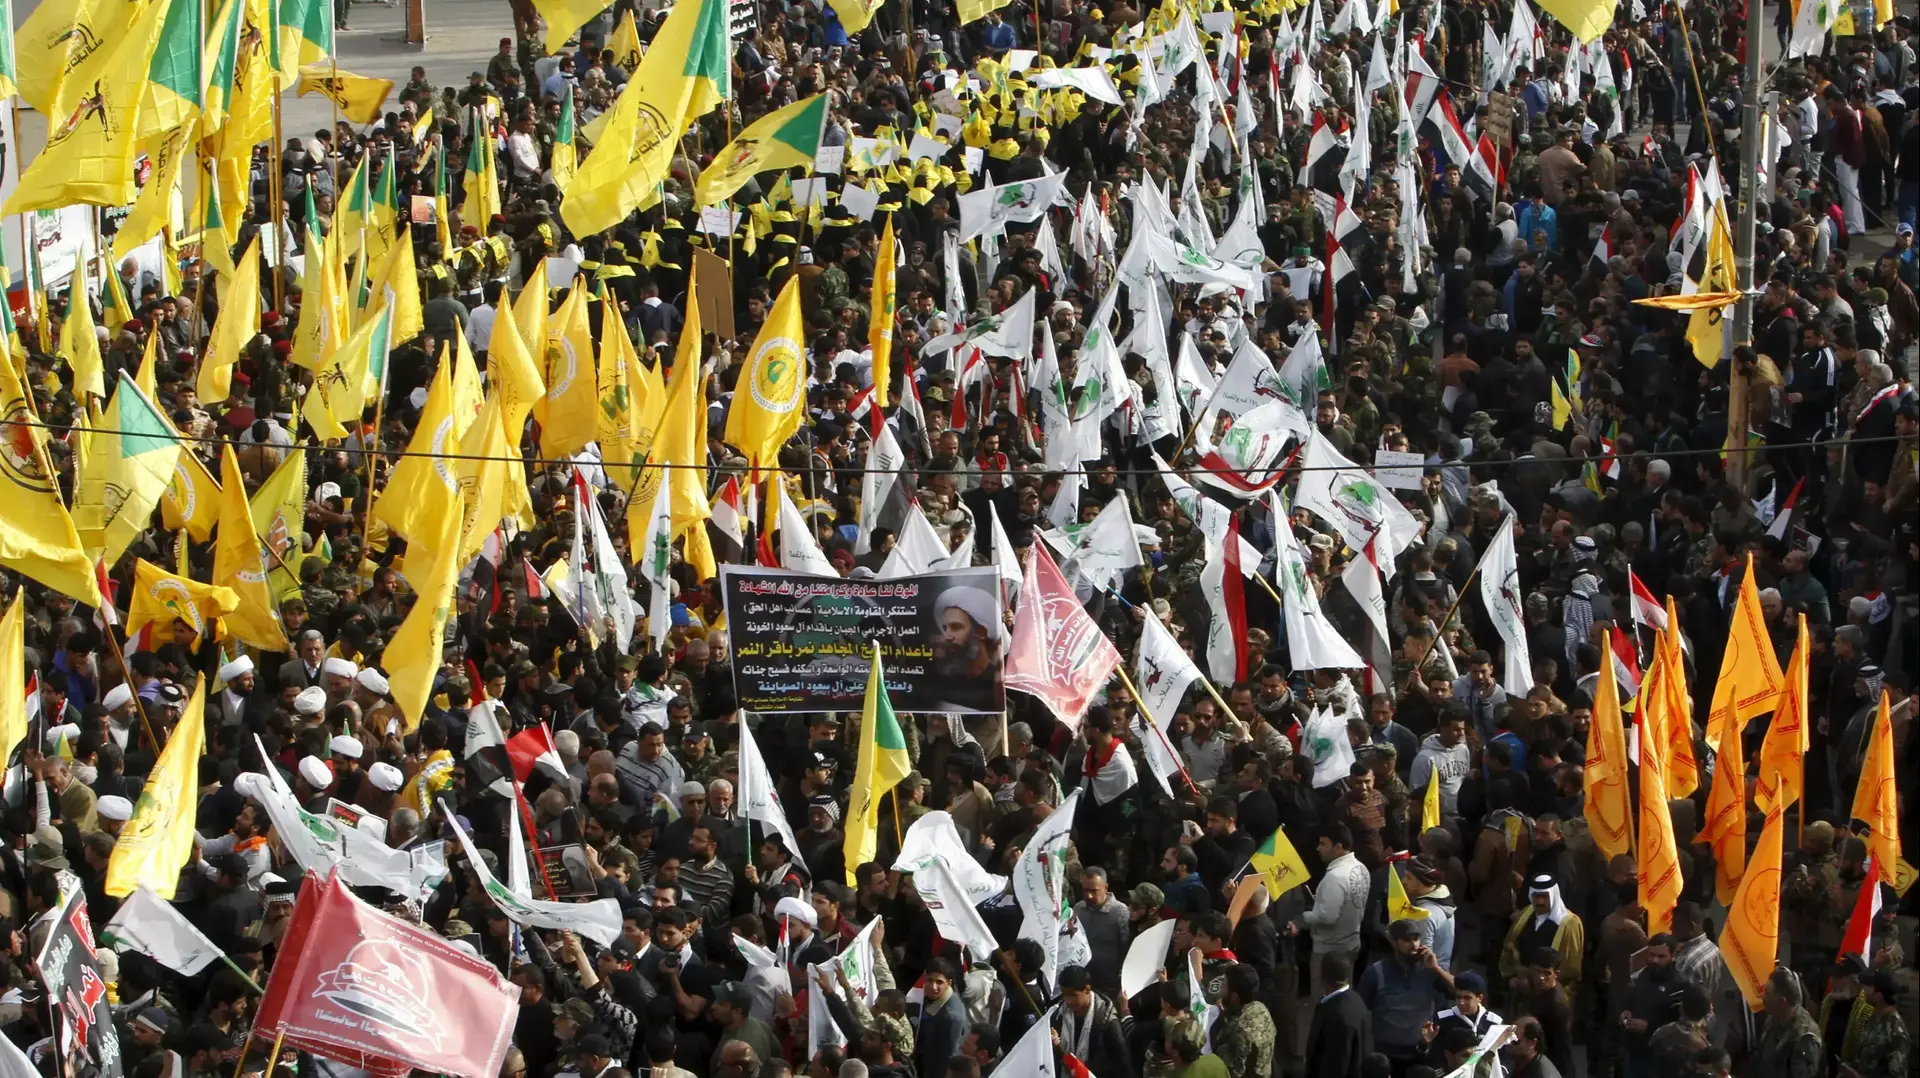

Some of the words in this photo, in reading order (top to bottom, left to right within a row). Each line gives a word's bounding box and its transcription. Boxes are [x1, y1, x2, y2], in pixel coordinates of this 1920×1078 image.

[739, 580, 776, 595] الشهادة
[777, 580, 794, 595] الله
[794, 583, 809, 598] من
[853, 584, 877, 597] عادة
[879, 584, 893, 597] لنا
[894, 583, 918, 599] الموت
[769, 603, 783, 613] اهل
[818, 605, 853, 616] الاسلامية
[855, 605, 884, 618] المقاومة
[887, 606, 917, 618] تستنكر
[747, 621, 774, 633] الخونة
[775, 622, 794, 633] سعود
[834, 625, 860, 636] الجبان
[862, 626, 896, 637] الاجرامي
[898, 626, 919, 636] العمل
[737, 642, 764, 657] النمر
[767, 641, 793, 658] باقر
[796, 641, 815, 656] نمر
[818, 643, 858, 658] المجاهد
[742, 664, 766, 676] جناته
[768, 664, 790, 677] فسيح
[822, 663, 852, 676] الواسعة
[886, 665, 899, 674] الله
[758, 680, 804, 694] الصهاينة
[807, 682, 831, 692] سعود
[845, 682, 865, 692] على
[886, 681, 913, 693] ولعنة
